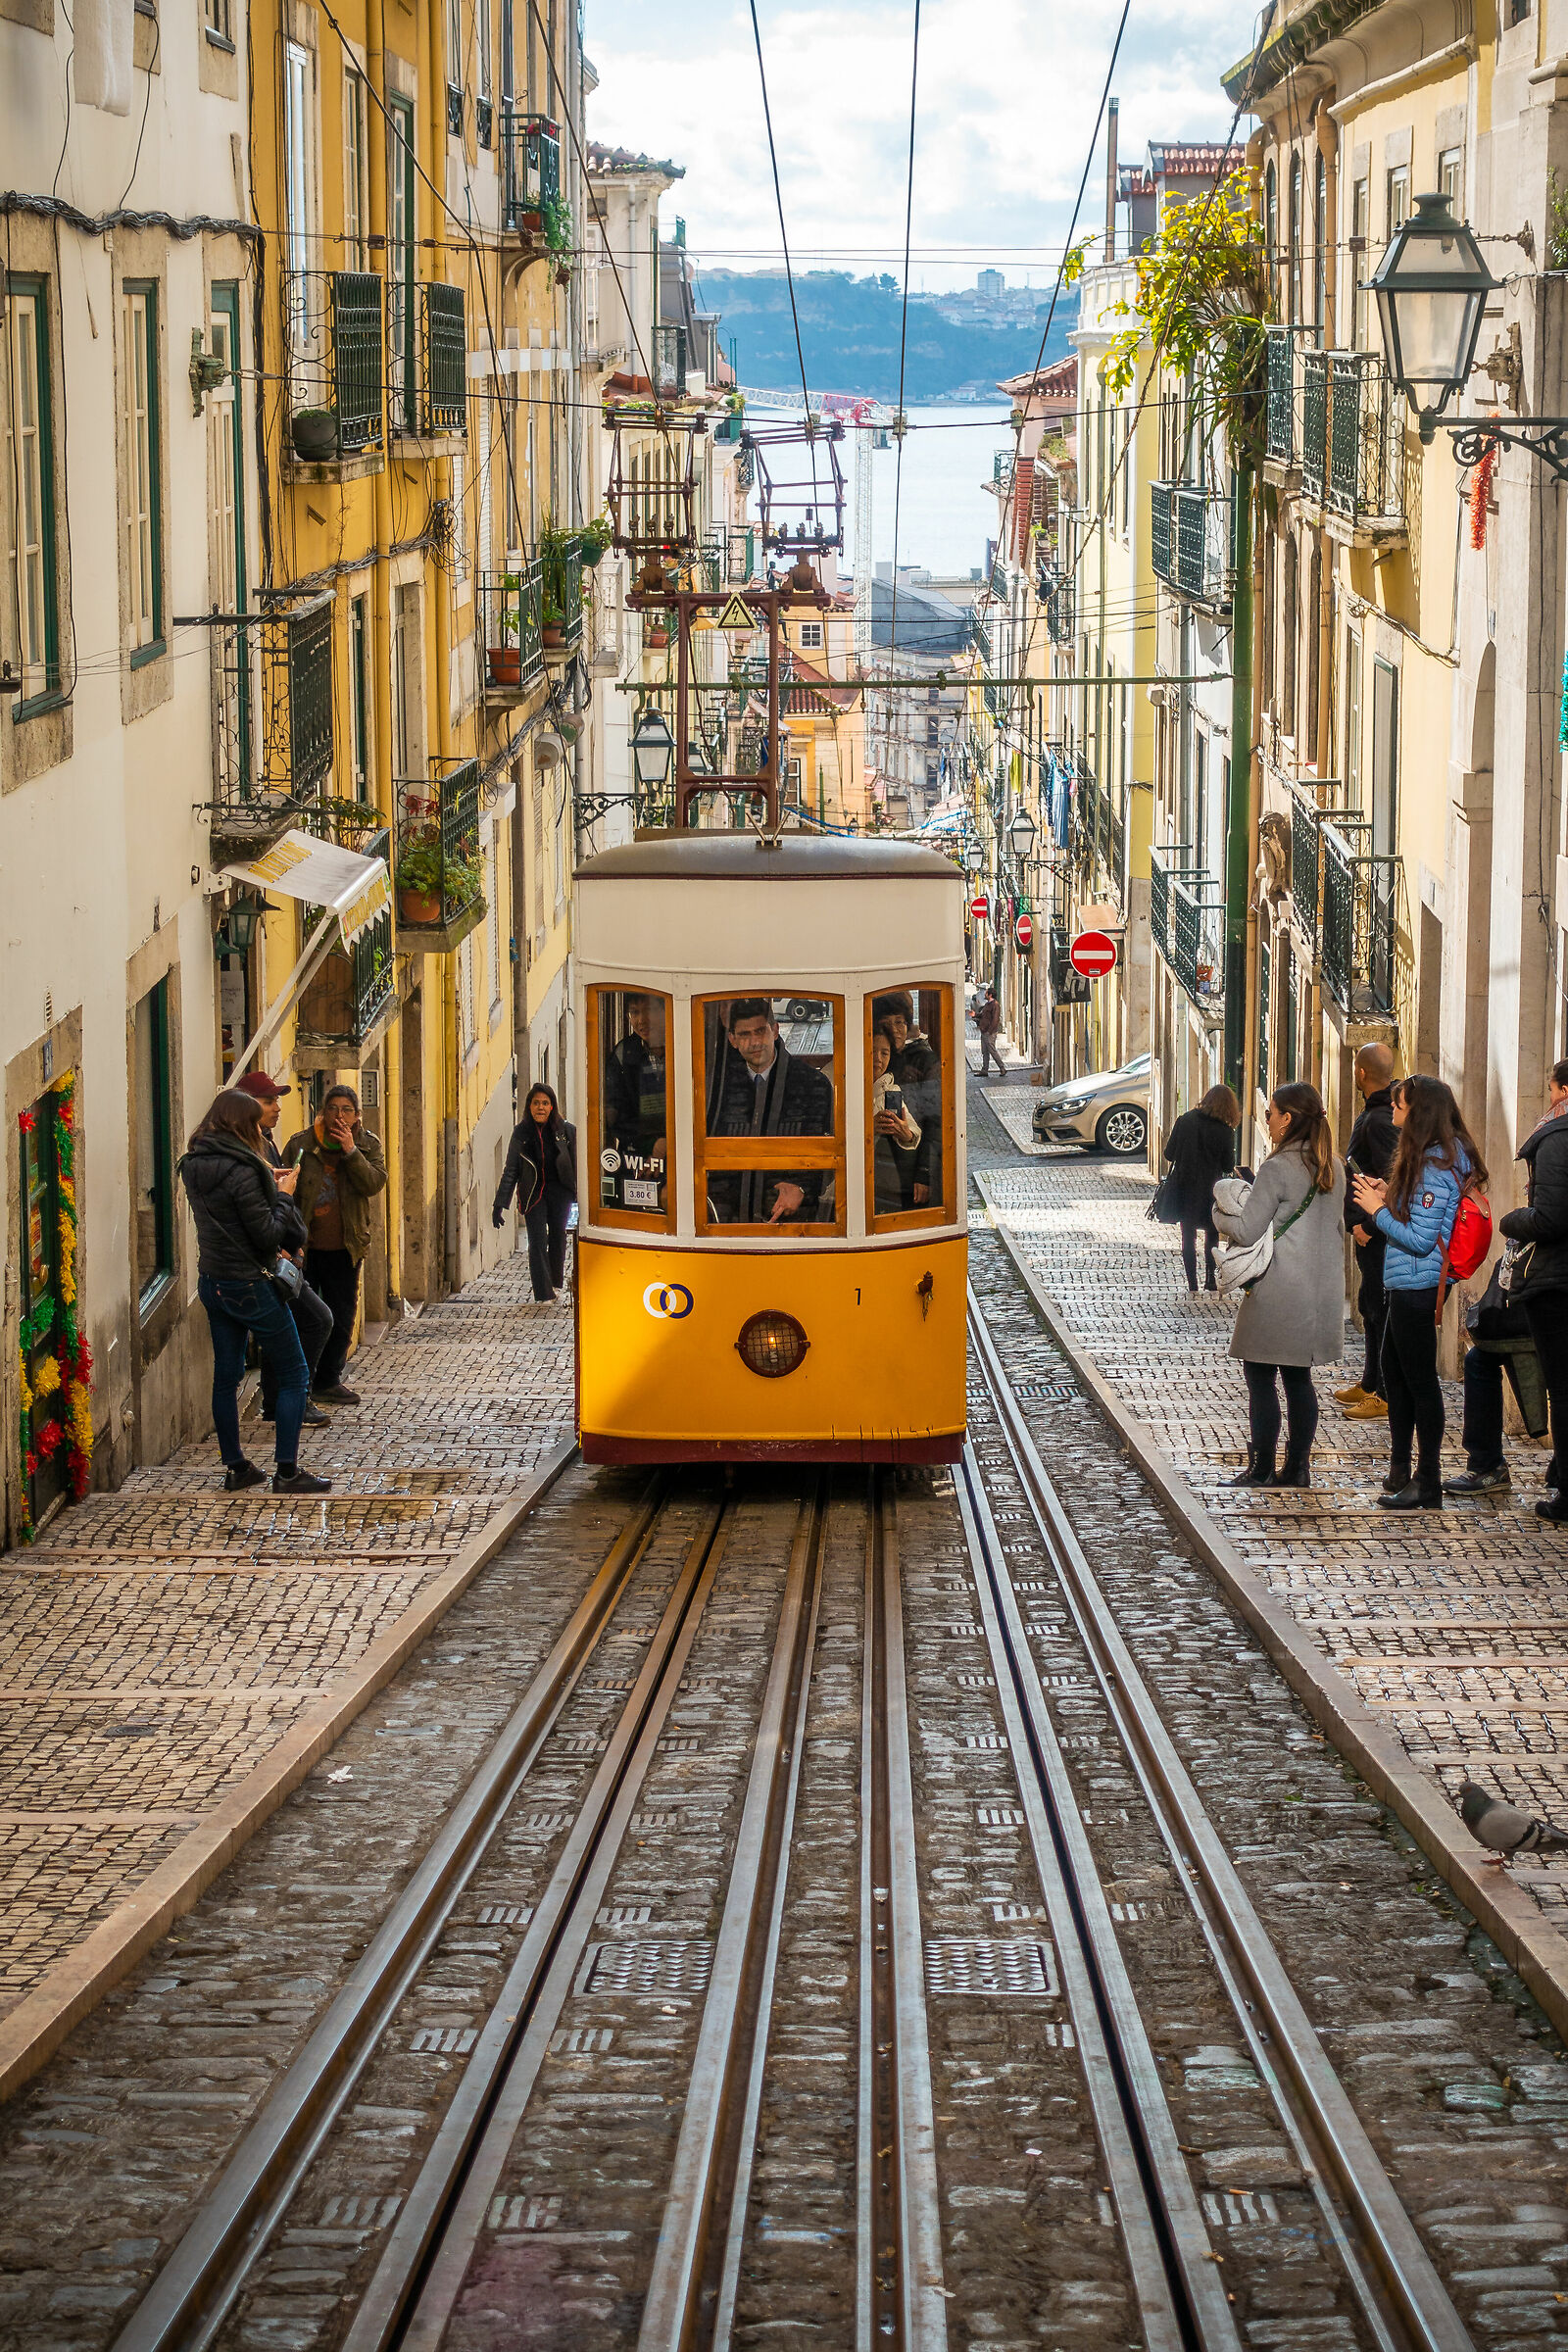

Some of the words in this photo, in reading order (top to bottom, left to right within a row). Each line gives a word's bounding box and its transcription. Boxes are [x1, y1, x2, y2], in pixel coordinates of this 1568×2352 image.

[624, 1154, 664, 1173] WI-FI
[629, 1190, 645, 1199] 3.80
[855, 1288, 861, 1305] 1
